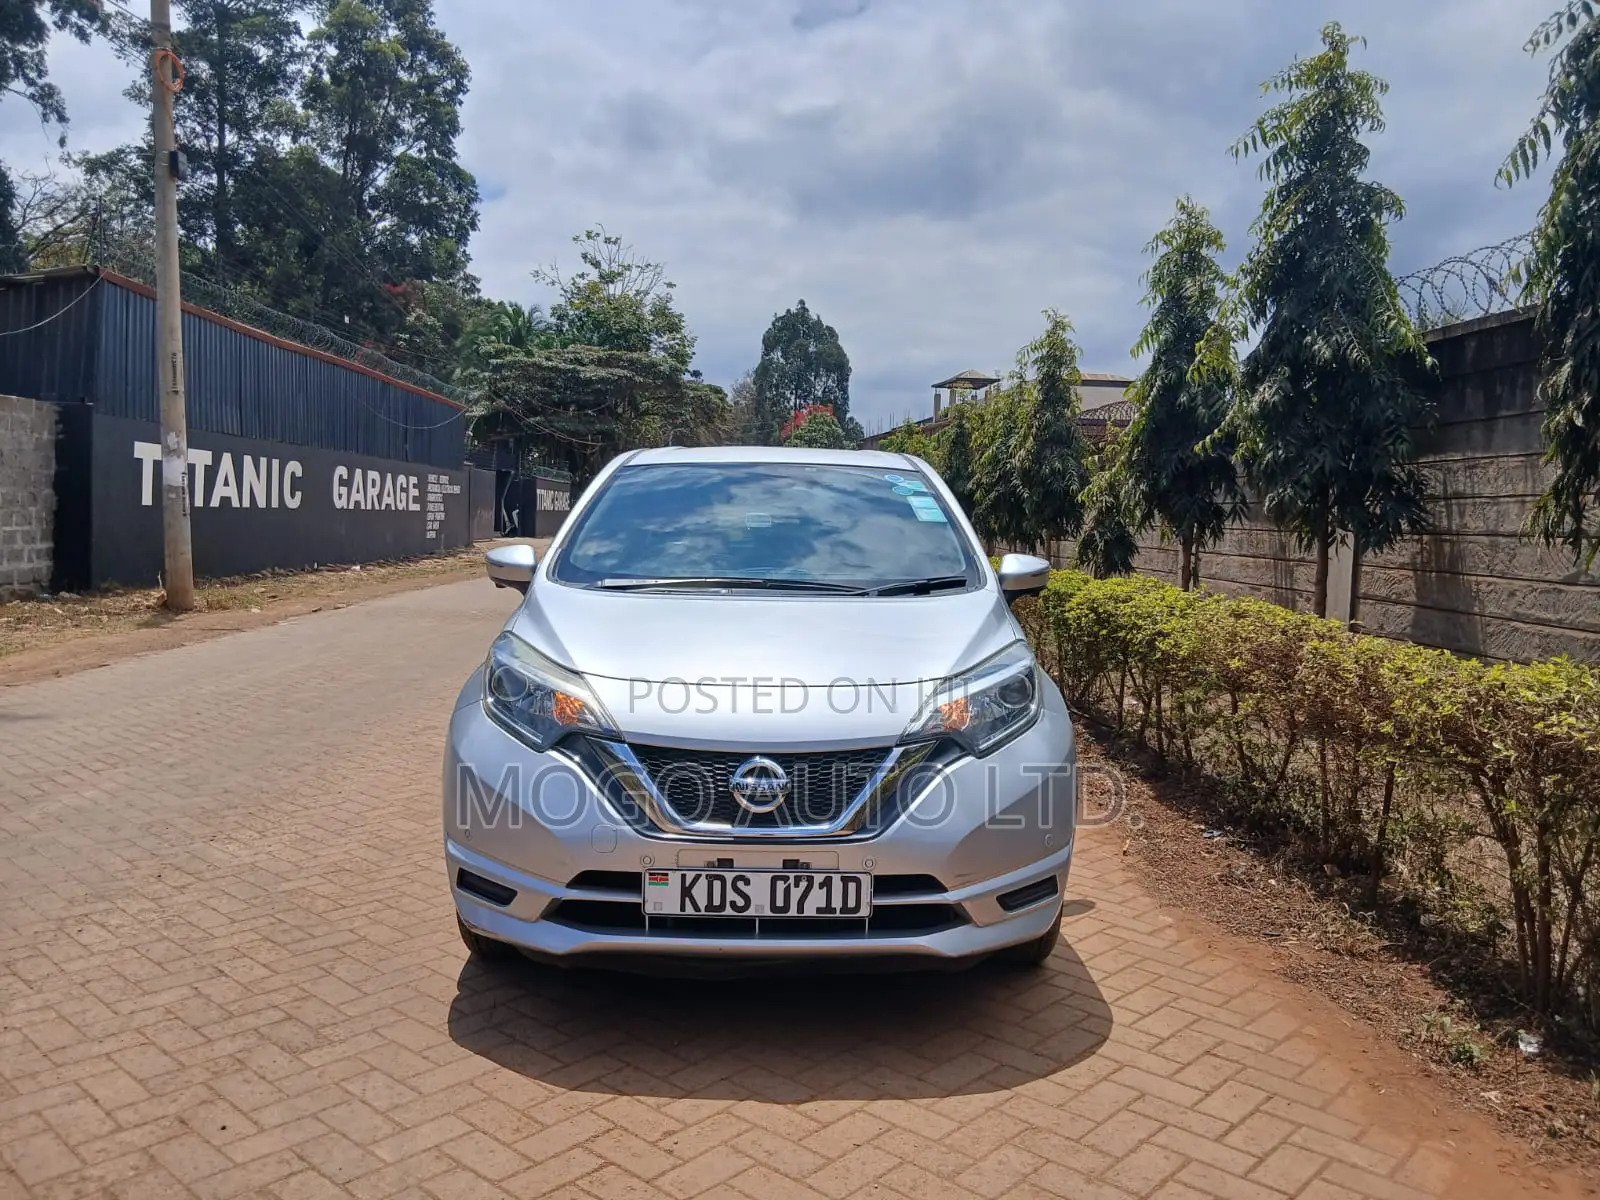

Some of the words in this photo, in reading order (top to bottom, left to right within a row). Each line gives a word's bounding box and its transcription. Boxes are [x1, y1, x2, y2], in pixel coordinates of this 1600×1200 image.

[134, 441, 302, 509] TTANIC
[333, 465, 420, 511] GARAGE
[735, 781, 786, 792] NISSAN
[679, 873, 752, 914] KDS
[769, 874, 862, 915] 071D
